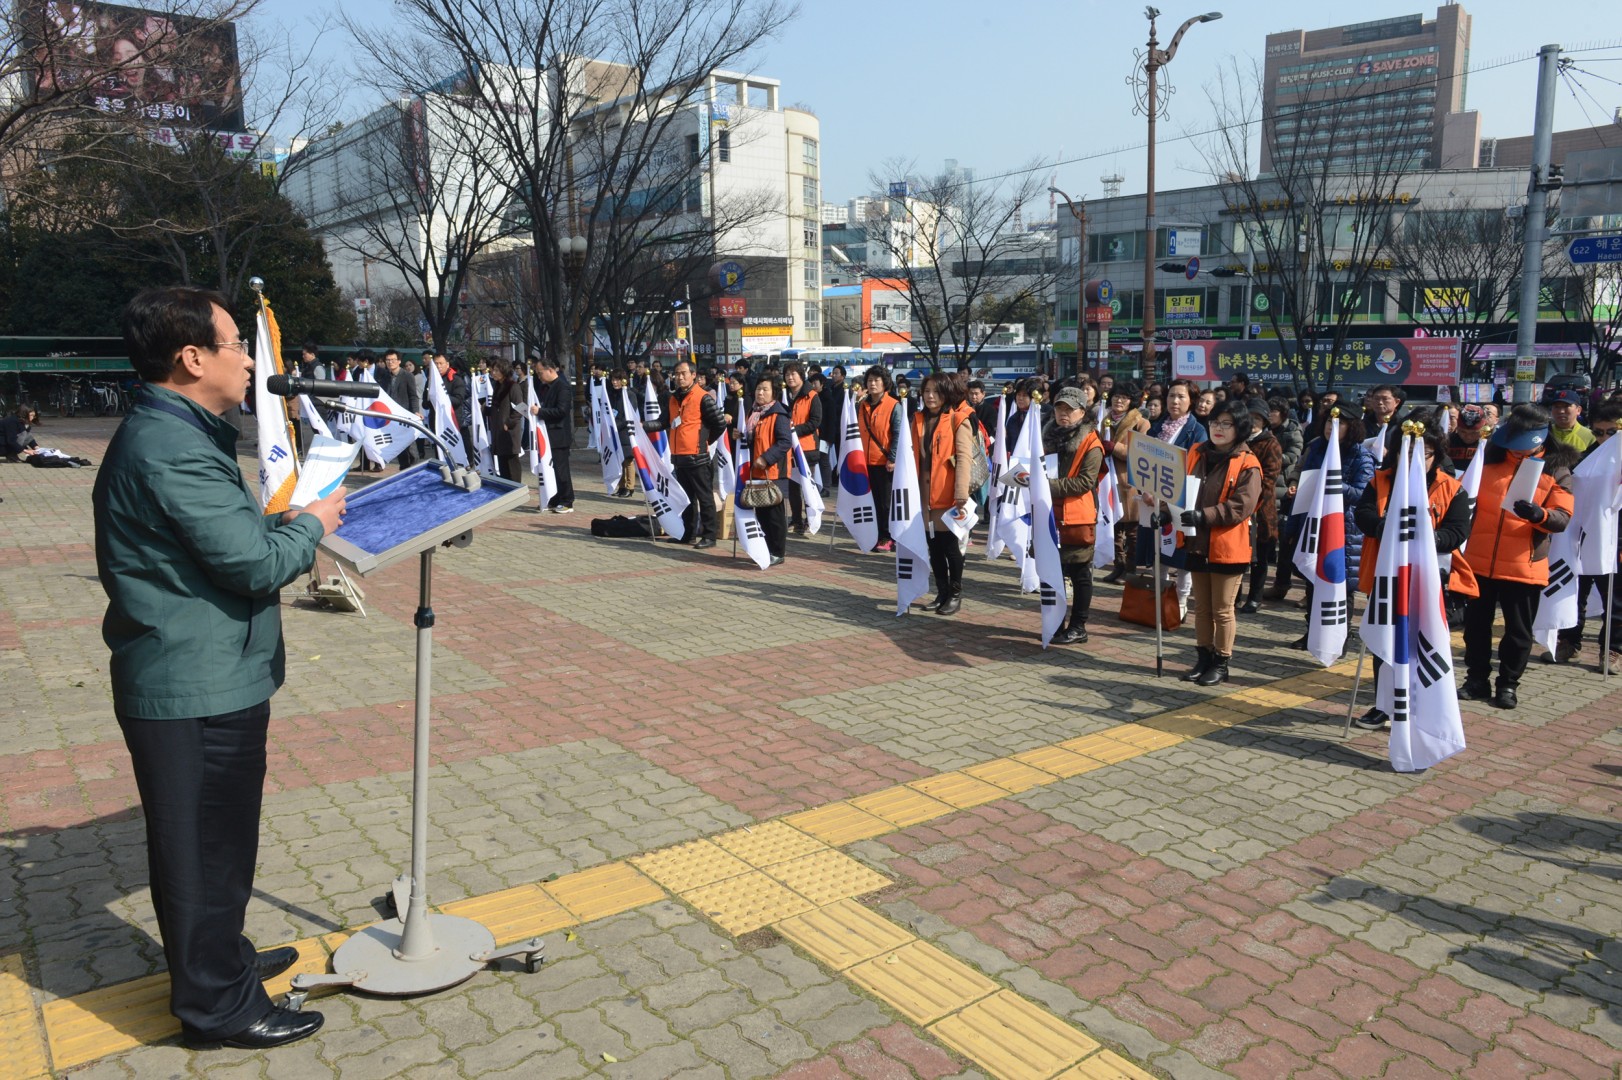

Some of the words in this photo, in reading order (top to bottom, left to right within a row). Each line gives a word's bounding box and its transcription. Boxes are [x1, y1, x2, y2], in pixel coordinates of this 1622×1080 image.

[1373, 59, 1402, 73] SAVE
[1402, 54, 1435, 69] ZONE
[1334, 67, 1354, 76] CLUB
[1573, 246, 1590, 255] 622
[1136, 457, 1175, 499] 우1동
